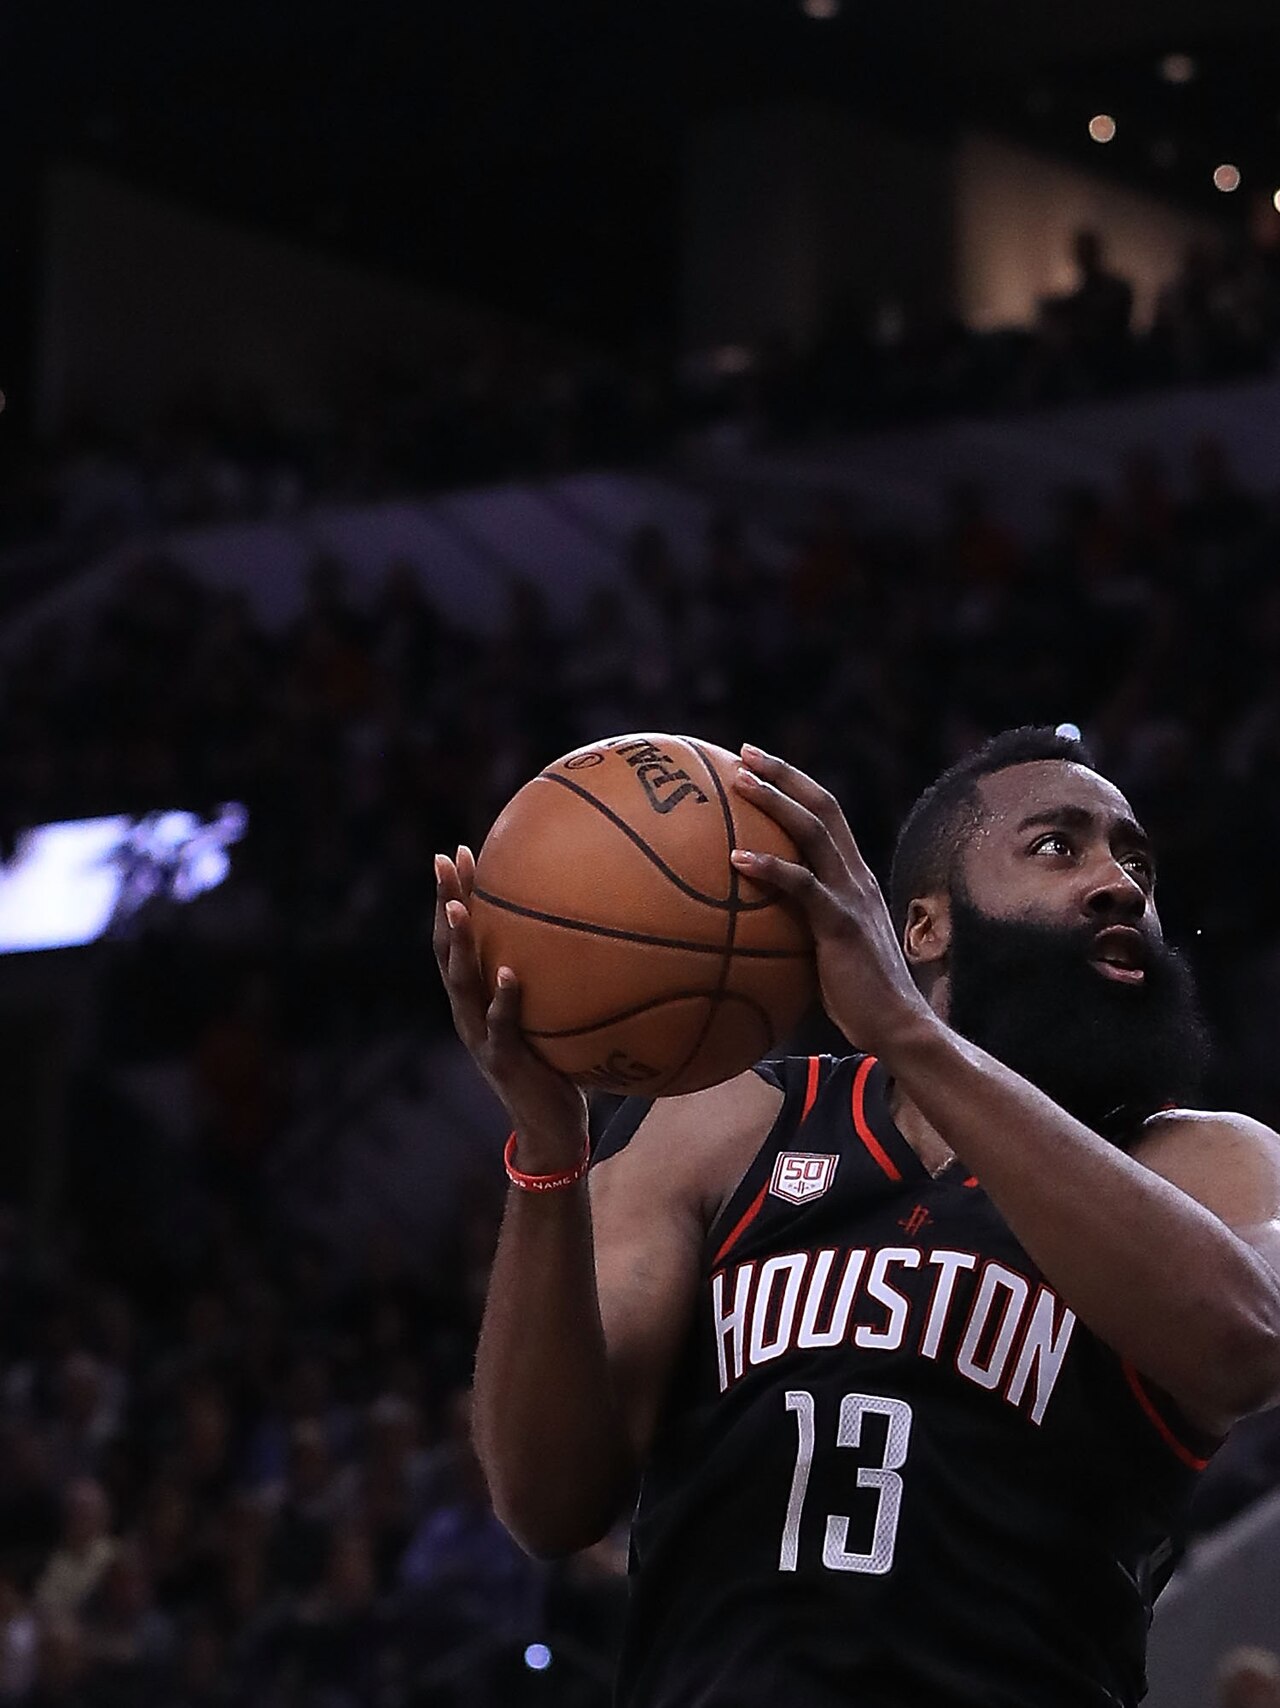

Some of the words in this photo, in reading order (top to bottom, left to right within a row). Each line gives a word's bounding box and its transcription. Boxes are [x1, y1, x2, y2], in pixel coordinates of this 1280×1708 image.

[607, 738, 709, 816] SPAL
[532, 1176, 572, 1190] NAME
[784, 1159, 825, 1180] 50
[711, 1246, 1077, 1427] HOUSTON
[778, 1390, 913, 1575] 13
